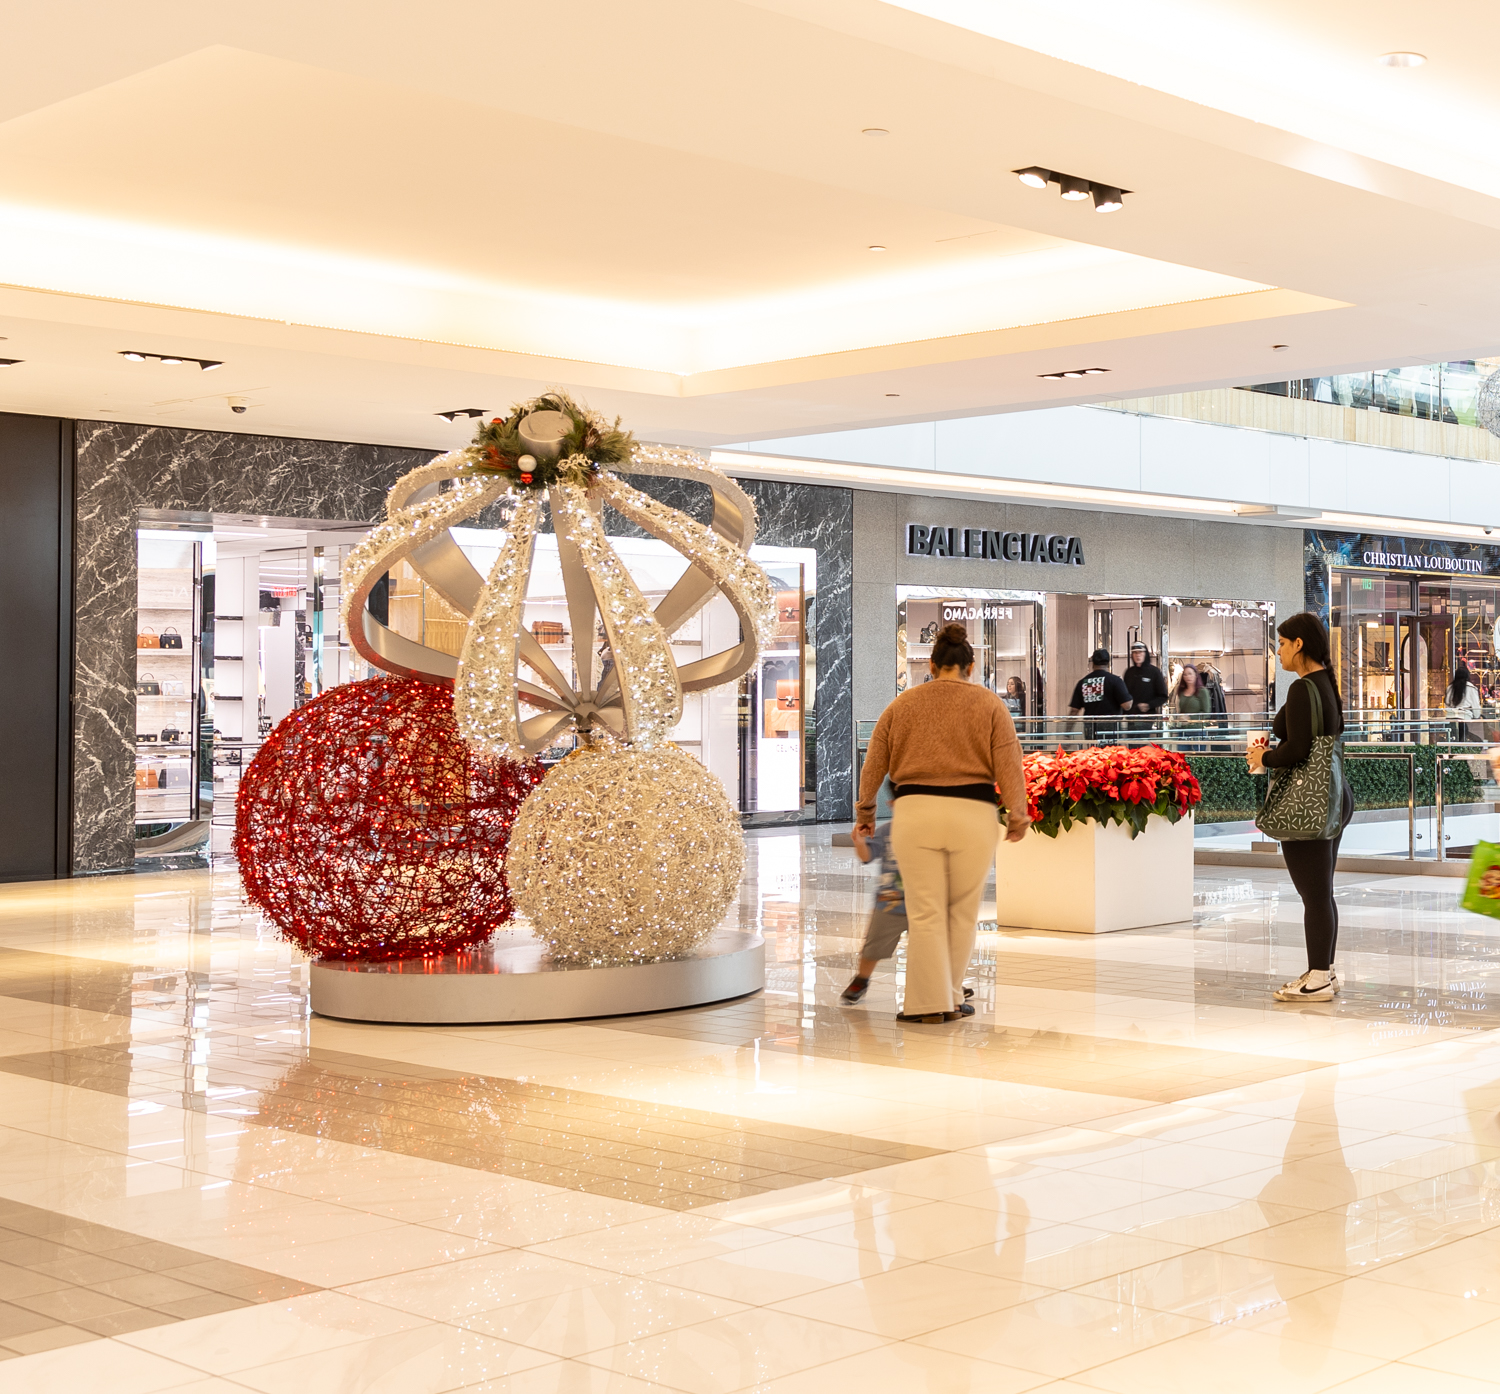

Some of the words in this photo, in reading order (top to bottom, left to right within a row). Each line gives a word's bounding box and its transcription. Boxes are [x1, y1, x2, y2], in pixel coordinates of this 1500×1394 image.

[909, 524, 1085, 565] BALENCIAGA
[1363, 551, 1421, 568] CHRISTIAN
[1424, 556, 1482, 572] LOUBOUTIN
